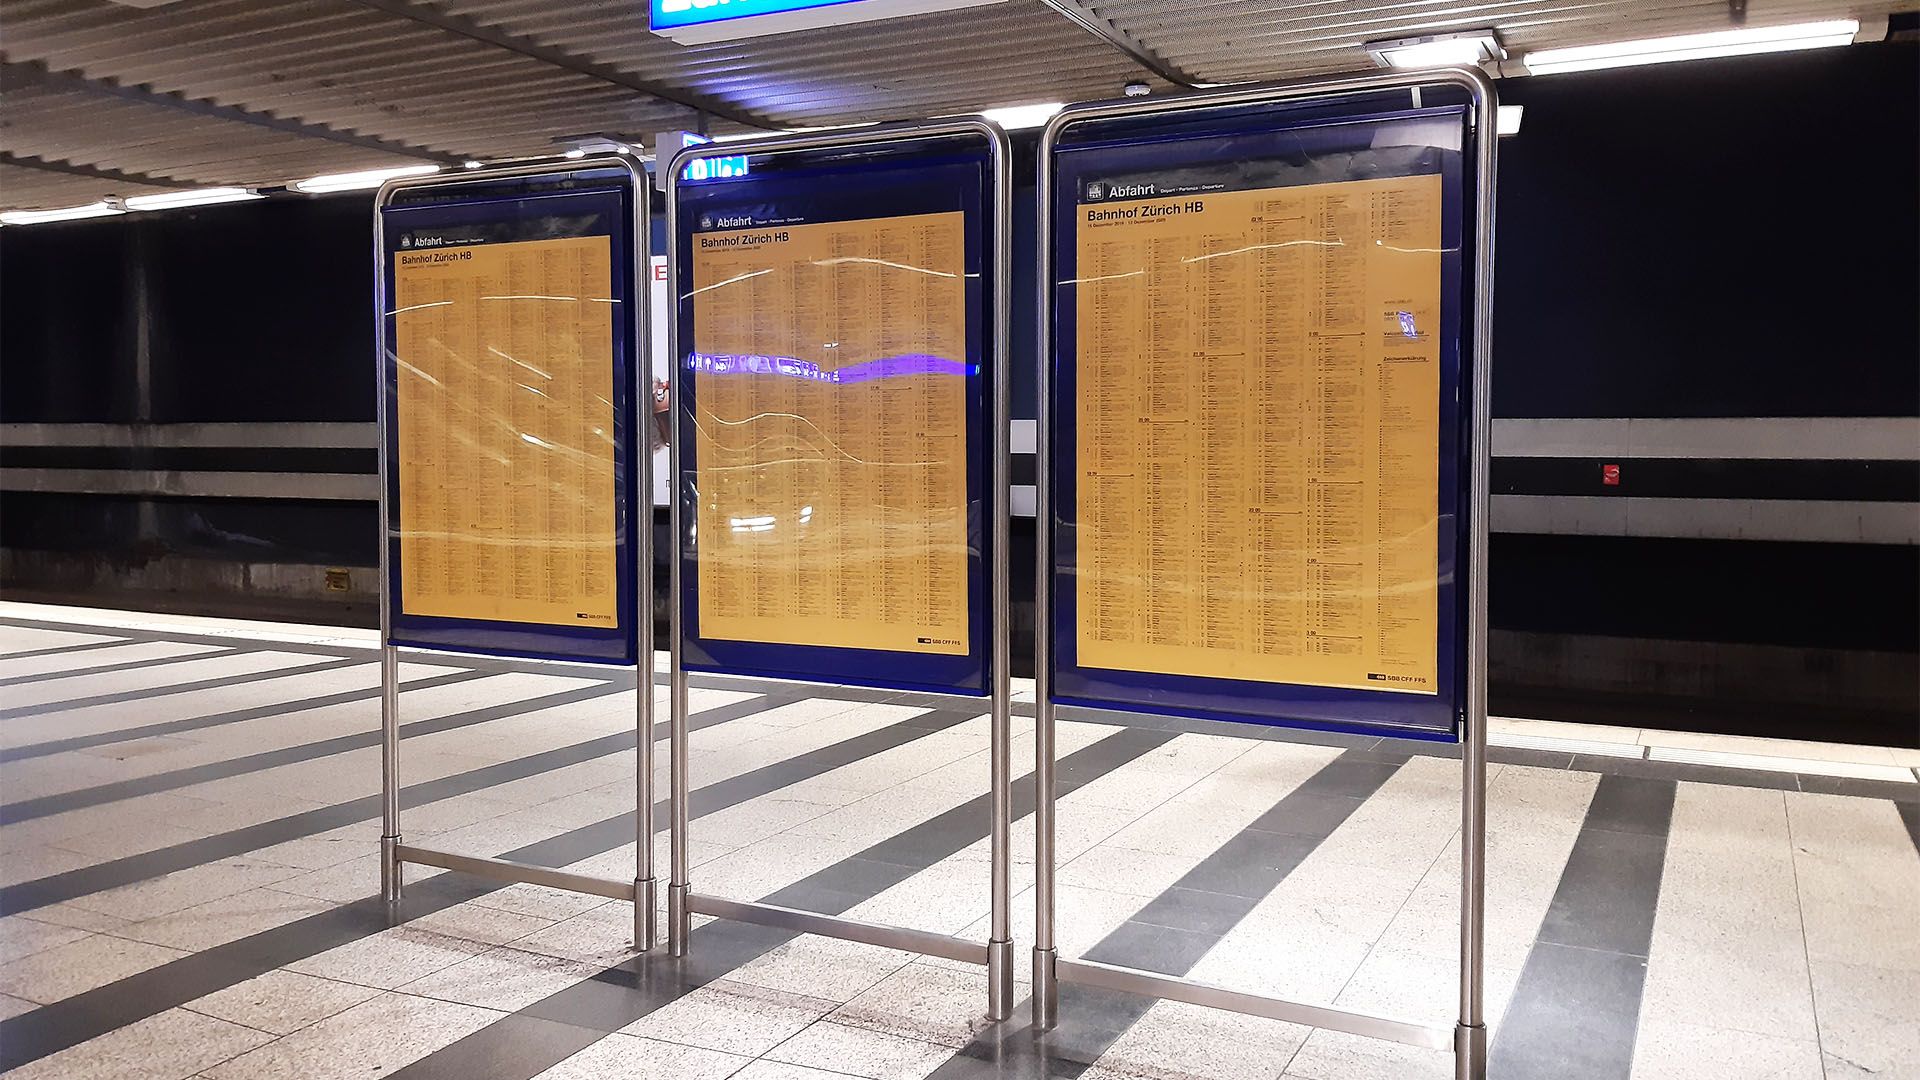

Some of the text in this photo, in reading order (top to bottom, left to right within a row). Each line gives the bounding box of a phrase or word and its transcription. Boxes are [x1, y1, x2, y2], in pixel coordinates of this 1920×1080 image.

[1109, 183, 1155, 198] Abfahrt
[1087, 201, 1204, 221] Bahnhof Zürich HB
[717, 215, 752, 228] Abfahrt
[414, 236, 442, 247] Abfahrt
[701, 232, 789, 248] Bahnhof Zürich HB
[401, 251, 472, 265] Bahnhof Zürich HB
